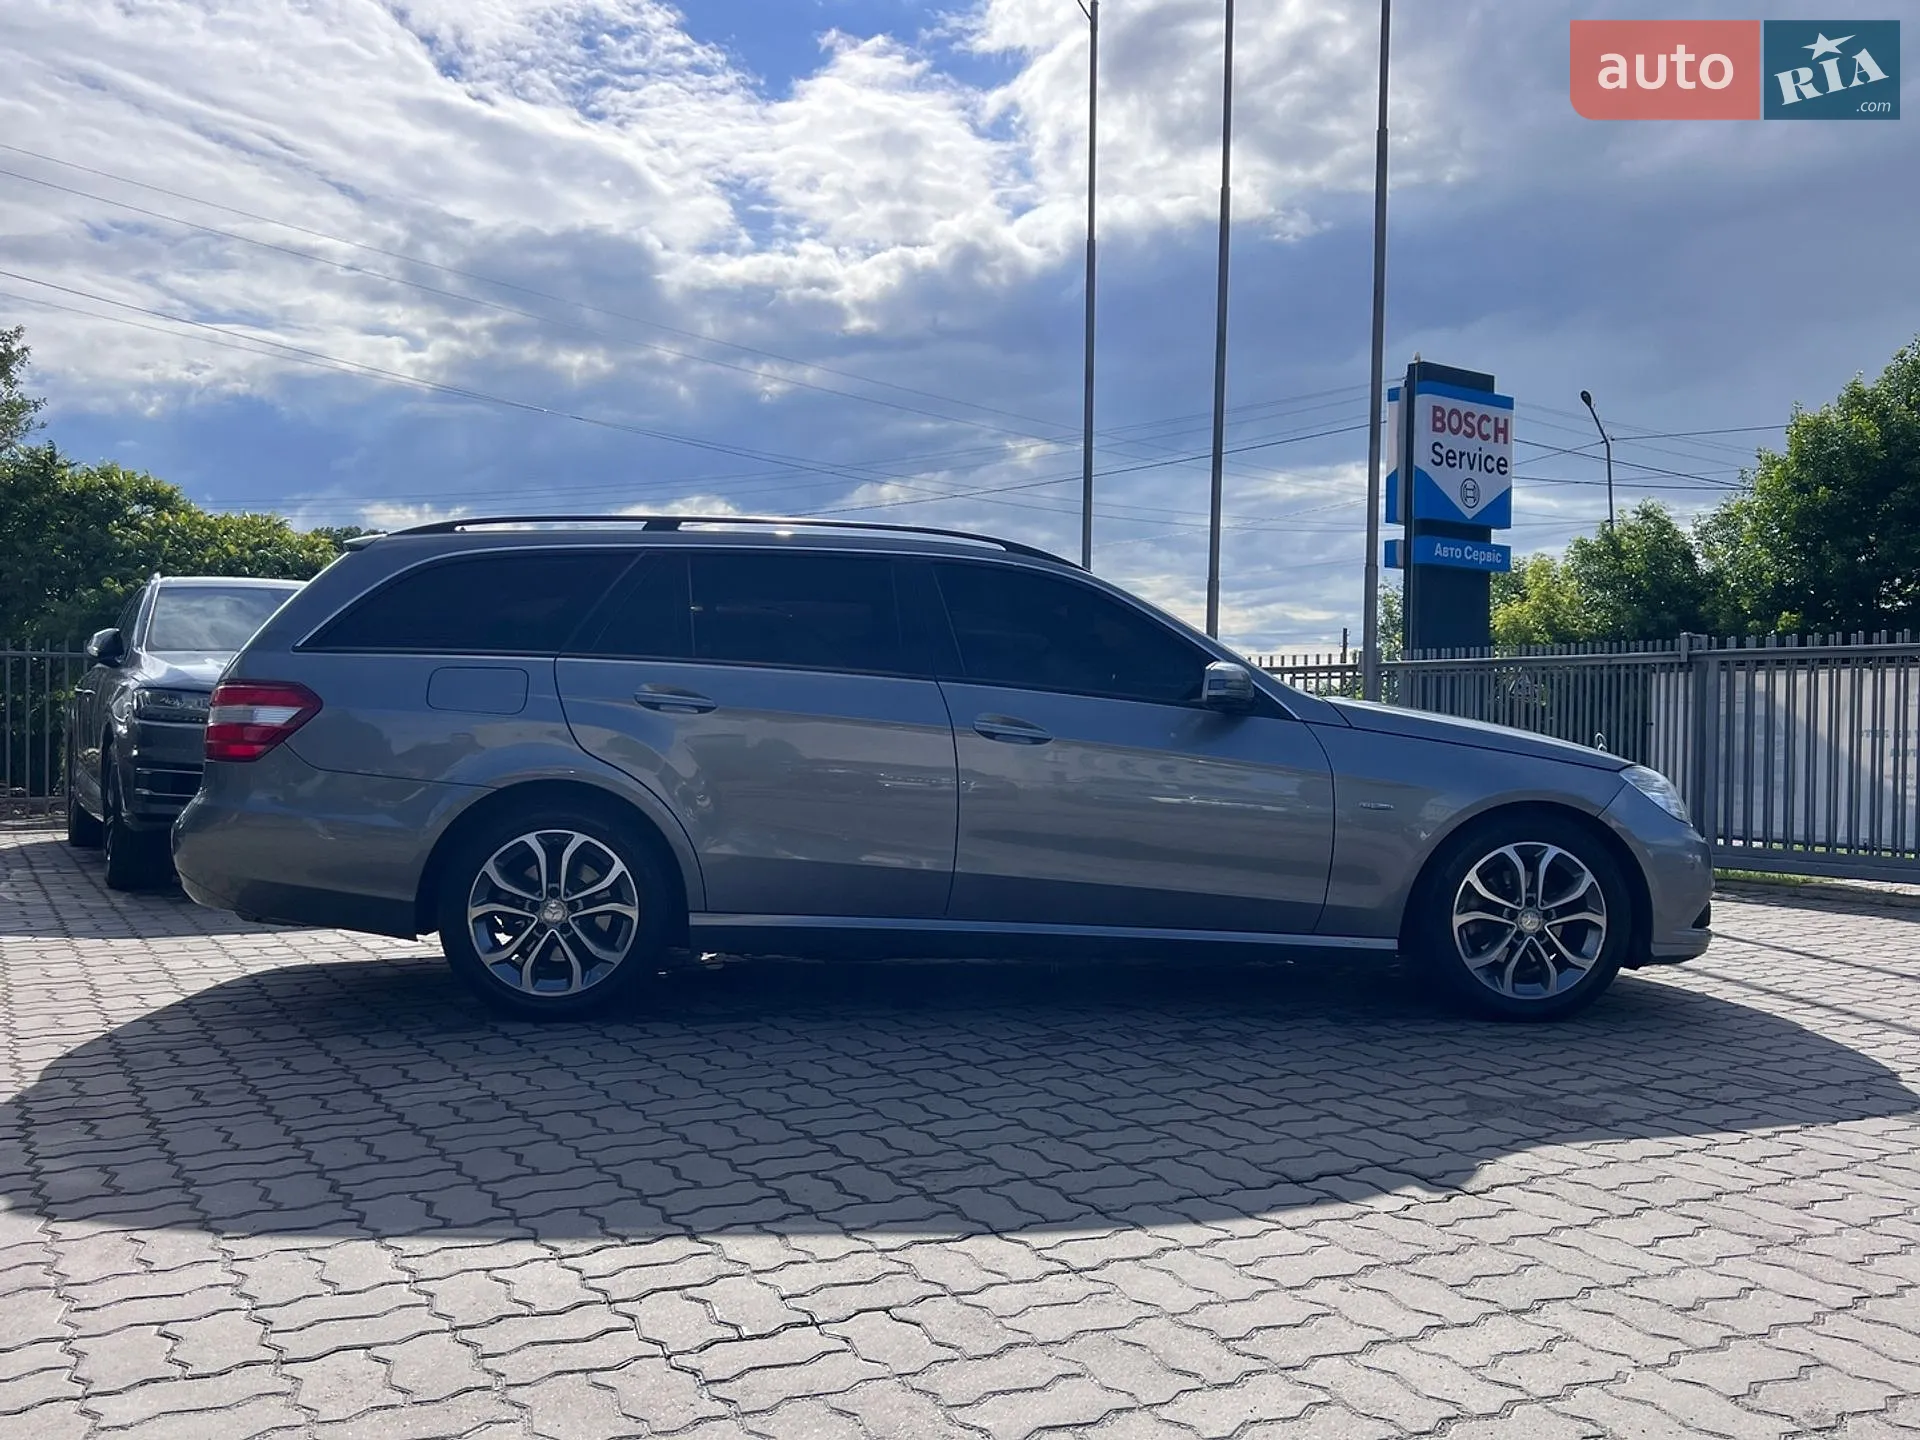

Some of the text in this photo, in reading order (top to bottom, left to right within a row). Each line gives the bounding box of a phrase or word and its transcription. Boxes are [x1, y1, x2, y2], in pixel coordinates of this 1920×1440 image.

[1431, 405, 1509, 445] BOSCH
[1431, 441, 1508, 476] Service
[1434, 542, 1502, 565] Авто Сервіс
